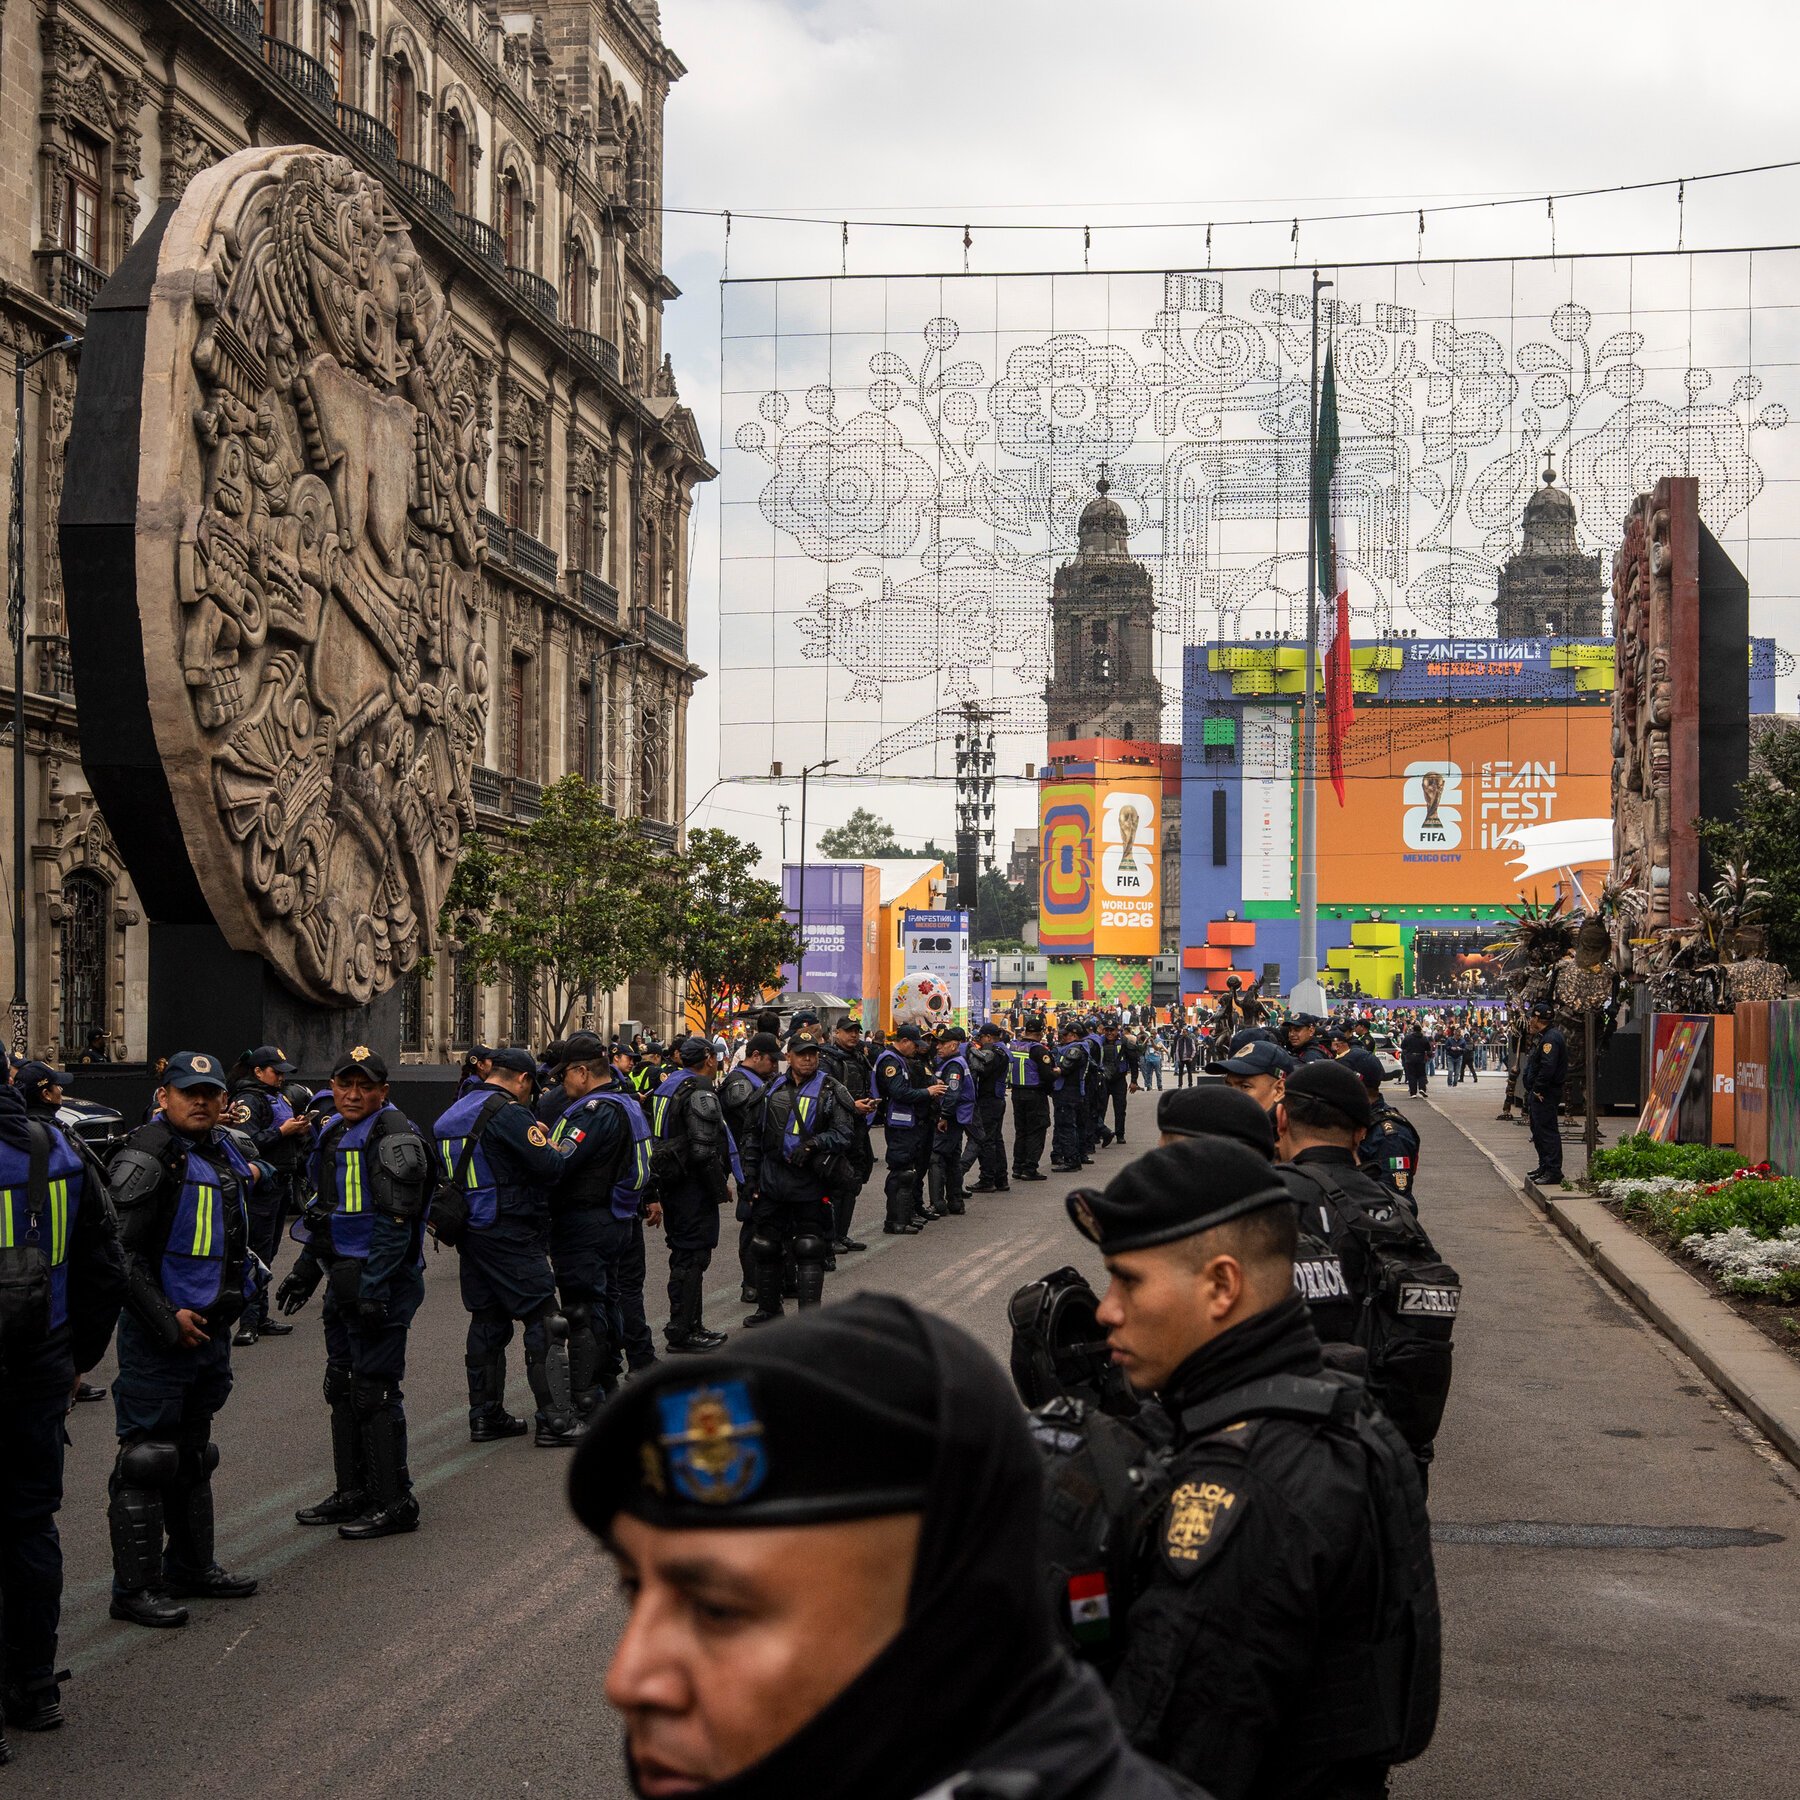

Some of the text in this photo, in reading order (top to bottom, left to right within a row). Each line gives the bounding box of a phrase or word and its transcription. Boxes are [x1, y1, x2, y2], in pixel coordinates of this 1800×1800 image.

[1427, 662, 1523, 676] MEXICO CITY
[1480, 761, 1492, 789] FIFA
[1494, 761, 1556, 789] FAN
[1481, 792, 1558, 819] FEST
[1420, 832, 1447, 842] FIFA
[1403, 854, 1462, 863] MEXICO CITY
[1117, 876, 1140, 887] FIFA
[1101, 900, 1154, 911] WORLD CUP
[1101, 911, 1154, 928] 2026
[919, 937, 952, 951] 26
